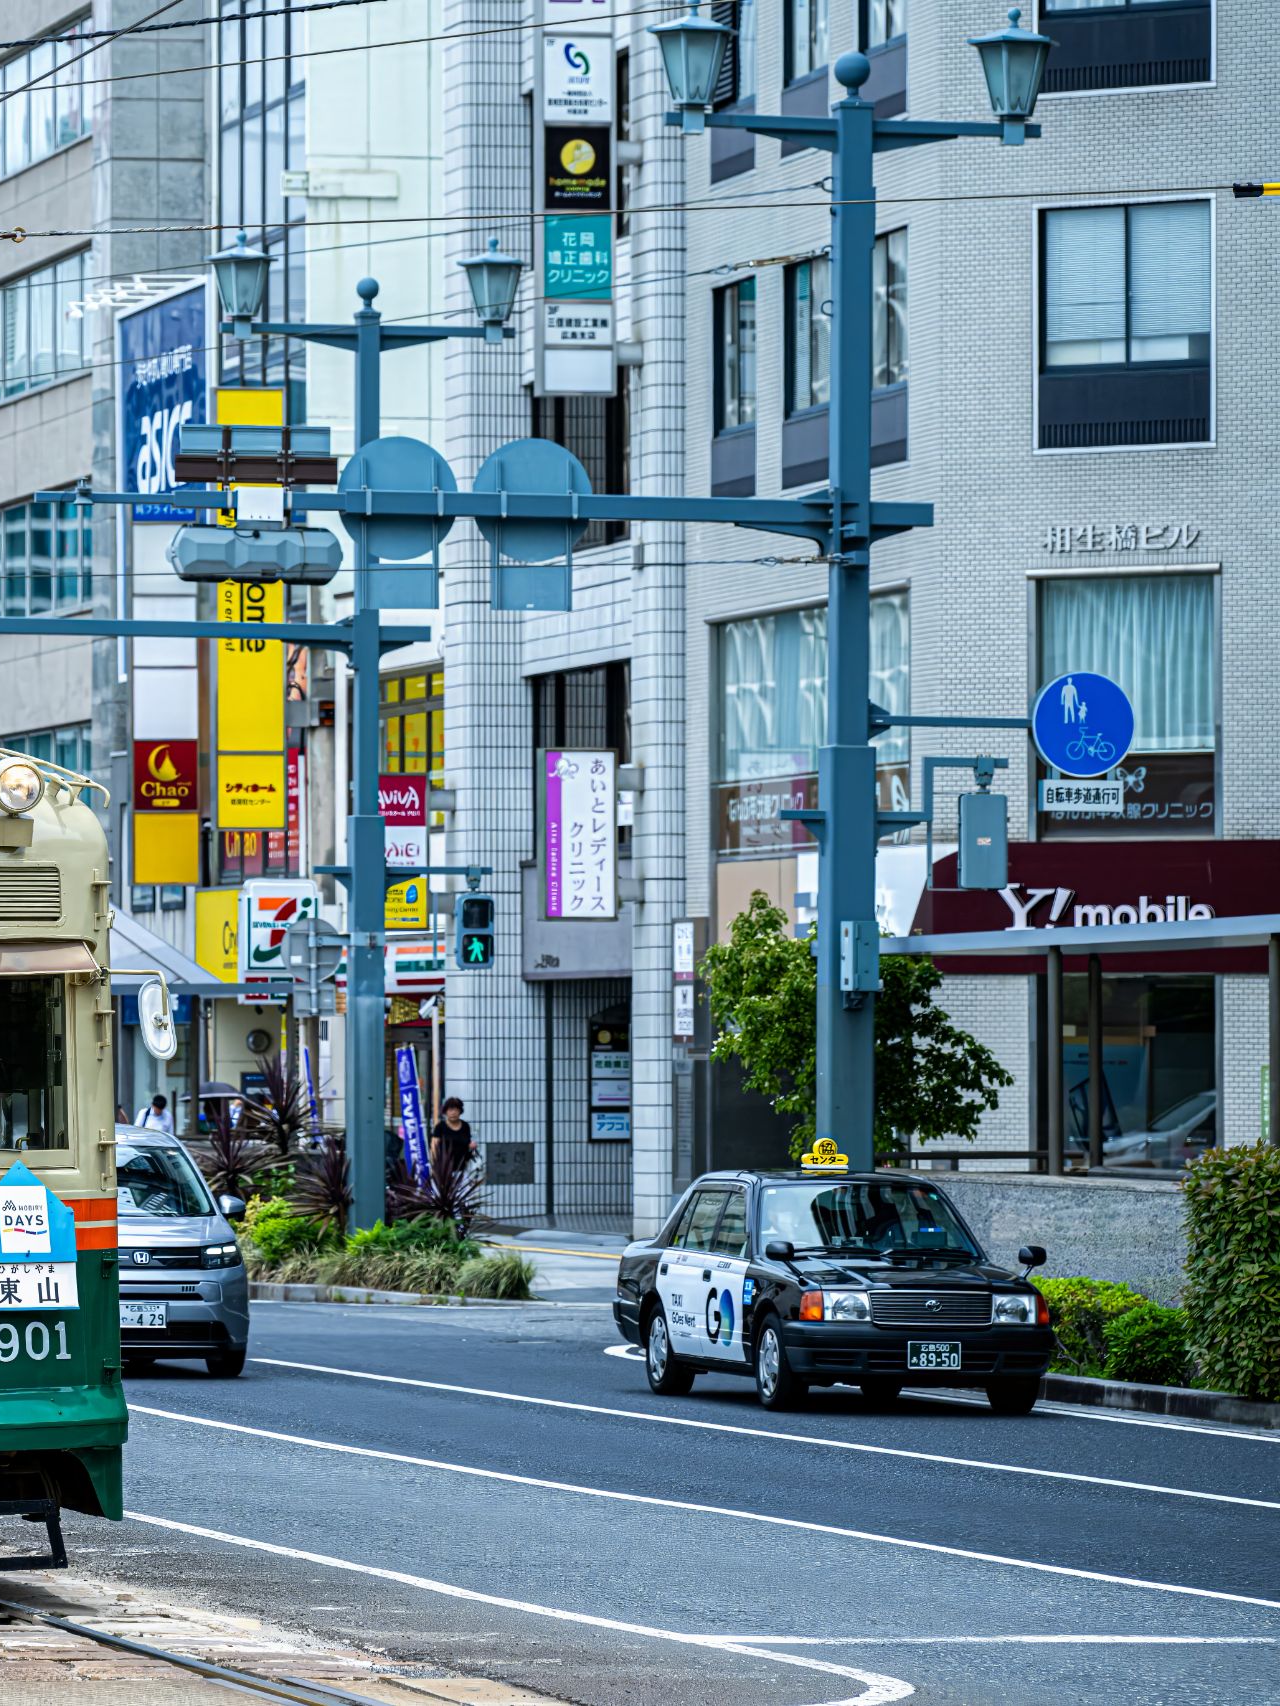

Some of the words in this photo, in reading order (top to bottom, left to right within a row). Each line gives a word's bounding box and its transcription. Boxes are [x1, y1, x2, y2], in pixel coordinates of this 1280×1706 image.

[549, 176, 607, 187] homemade
[562, 231, 595, 247] 花岡
[548, 250, 608, 265] 矯正歯科
[547, 269, 609, 284] クリニック
[1044, 523, 1201, 553] 相生橋ビル
[140, 781, 189, 797] Chao
[225, 783, 277, 794] シティホーム
[1046, 786, 1120, 805] 自転車歩道通行可
[590, 758, 607, 912] あいとレディース
[569, 822, 586, 912] クリニック
[810, 1155, 845, 1165] センター
[4, 1214, 44, 1226] DAYS
[671, 1293, 683, 1307] TAXI
[920, 1353, 958, 1367] 89-50
